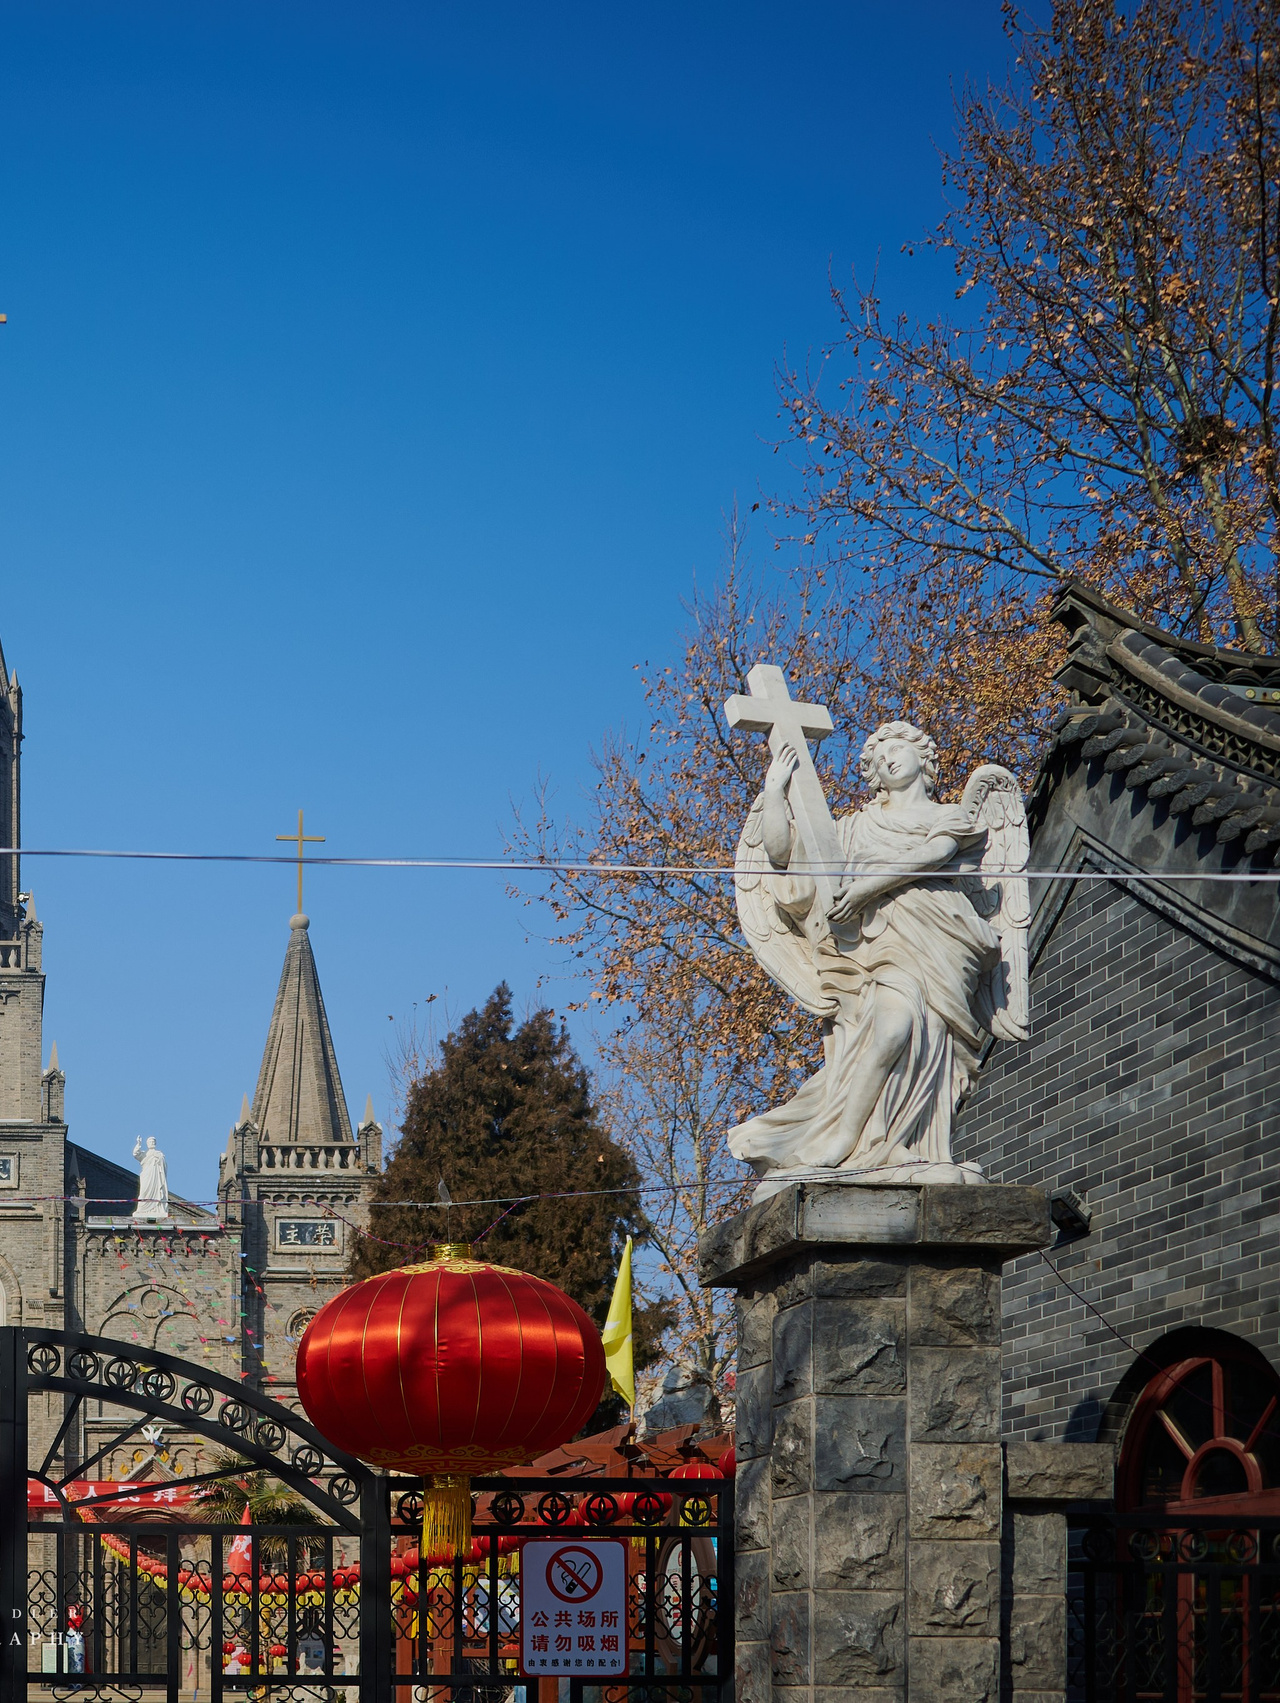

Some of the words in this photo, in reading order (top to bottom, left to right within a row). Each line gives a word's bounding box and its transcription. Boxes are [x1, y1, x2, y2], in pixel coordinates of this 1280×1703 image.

[531, 1610, 618, 1628] 公共场所
[531, 1634, 619, 1652] 请勿吸烟
